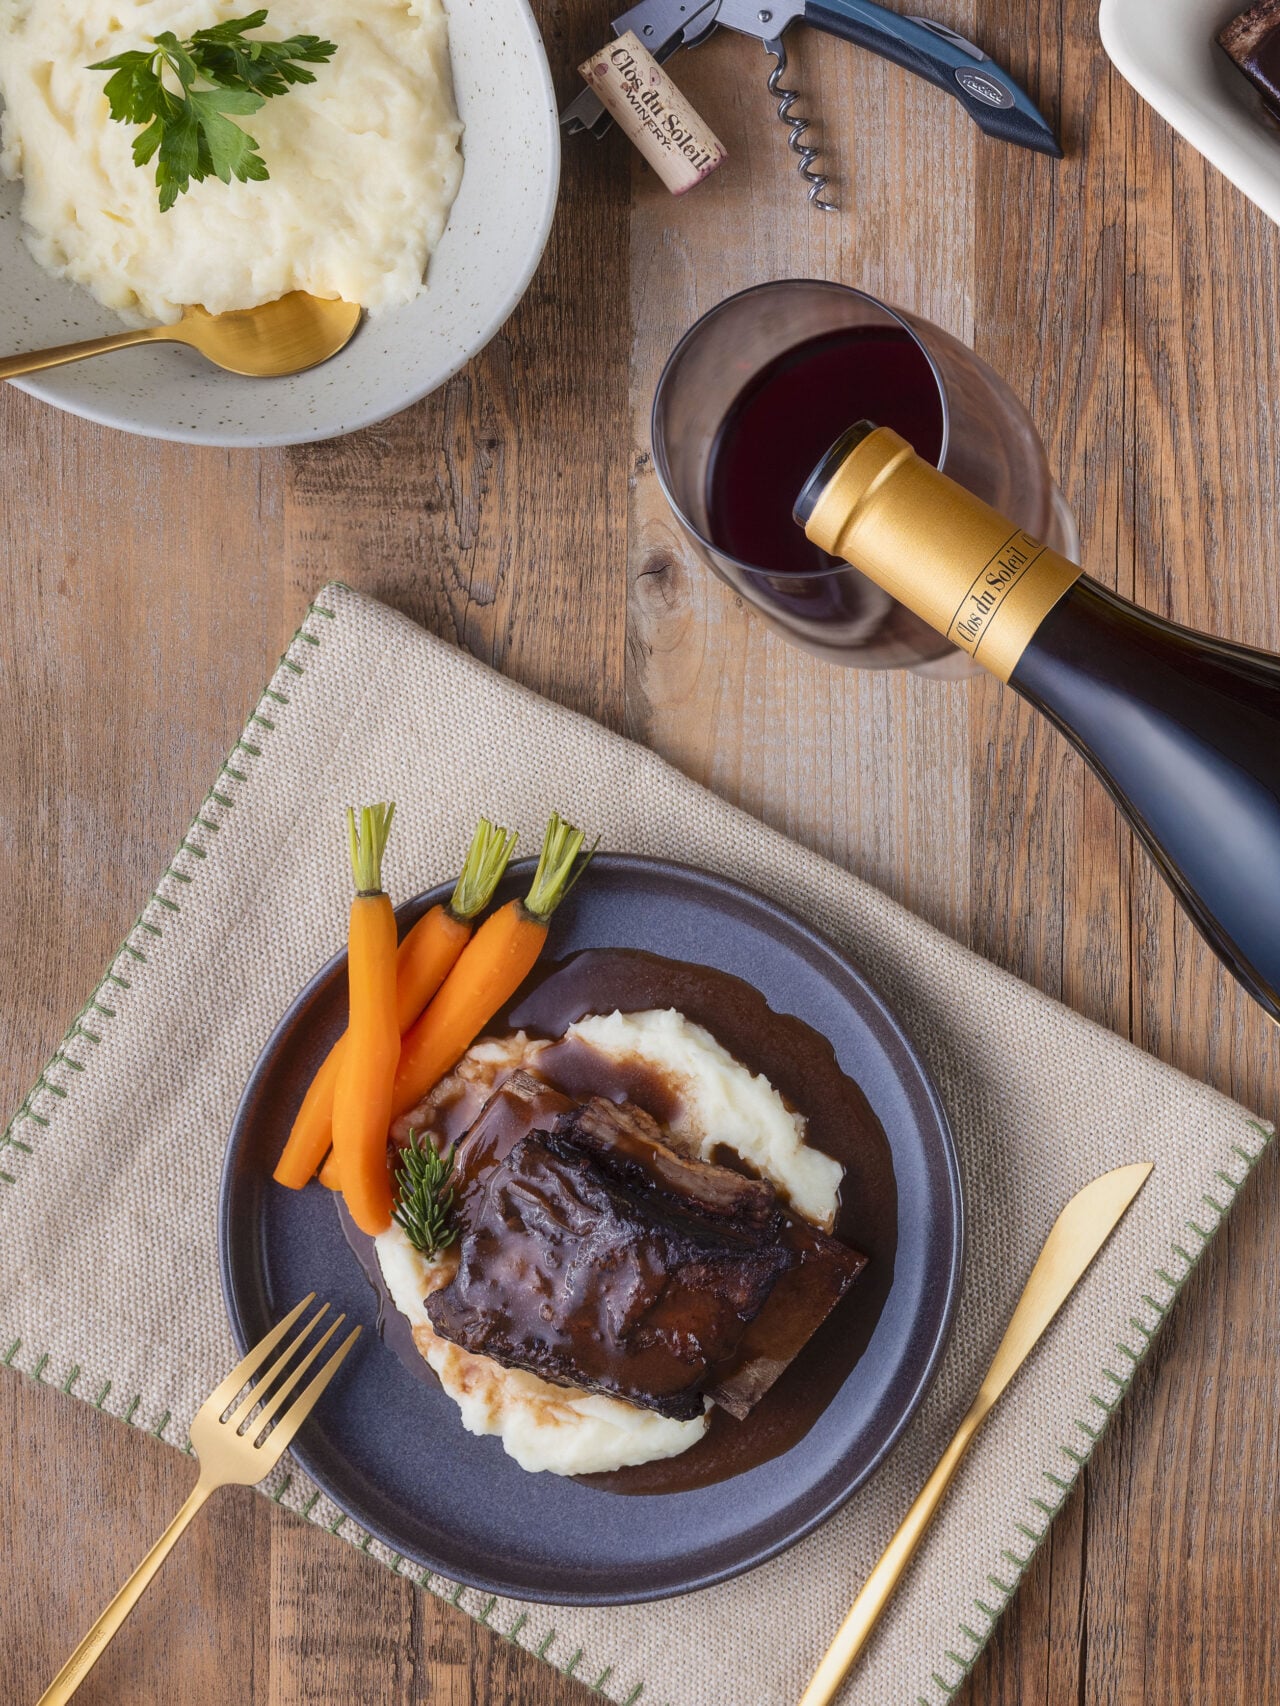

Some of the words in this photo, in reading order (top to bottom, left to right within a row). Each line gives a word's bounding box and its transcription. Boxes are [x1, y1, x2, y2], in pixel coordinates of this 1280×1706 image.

[610, 48, 643, 90] Clos
[641, 90, 664, 117] du
[661, 114, 711, 171] Soleil
[956, 613, 982, 642] Clos
[970, 590, 996, 615] du
[985, 546, 1028, 592] Soleil
